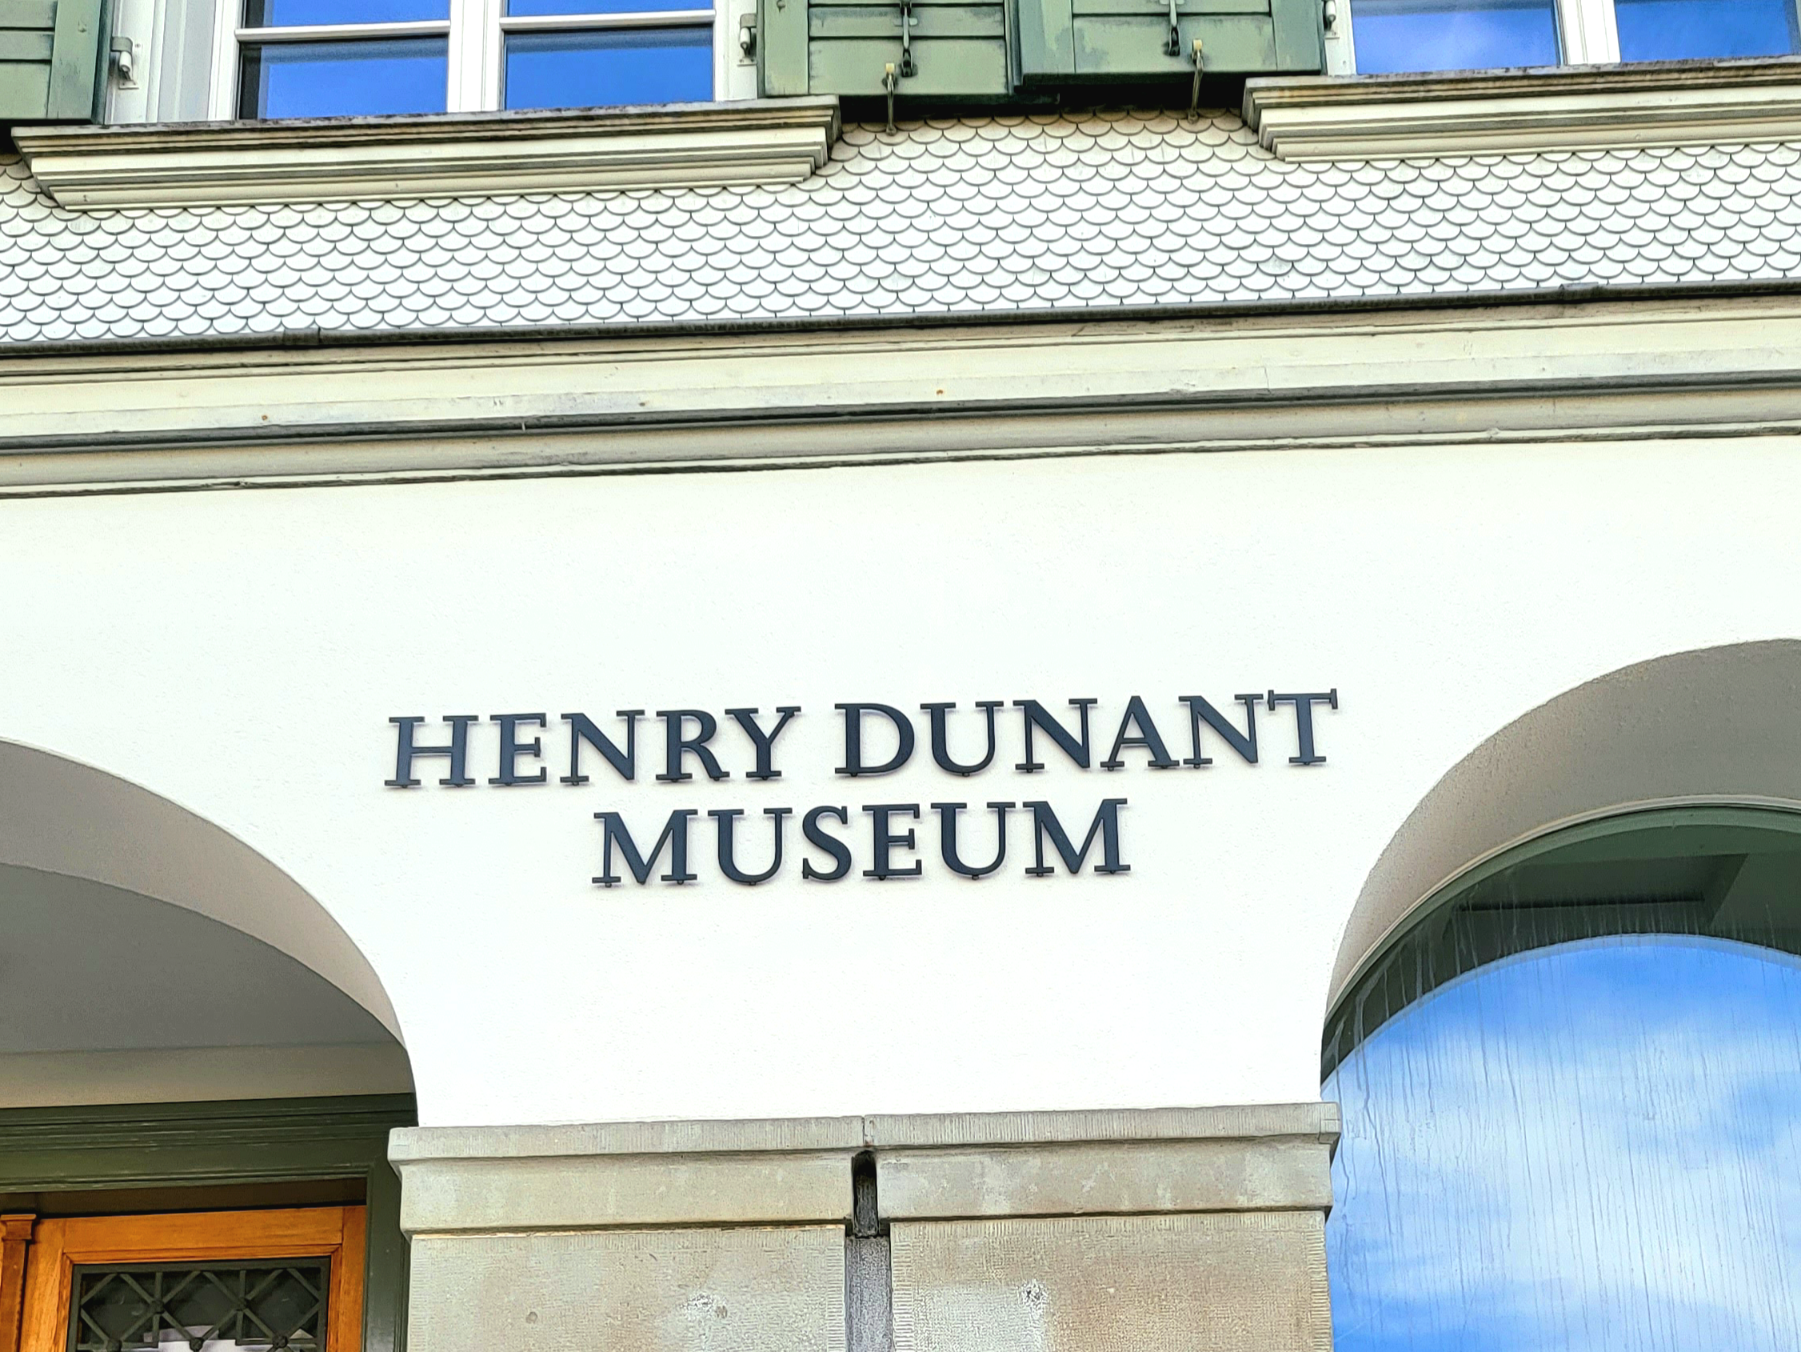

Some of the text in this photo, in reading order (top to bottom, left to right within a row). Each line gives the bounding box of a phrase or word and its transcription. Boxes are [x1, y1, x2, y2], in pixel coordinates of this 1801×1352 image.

[384, 689, 1338, 788] HENRY DUNANT
[592, 798, 1131, 887] MUSEUM
